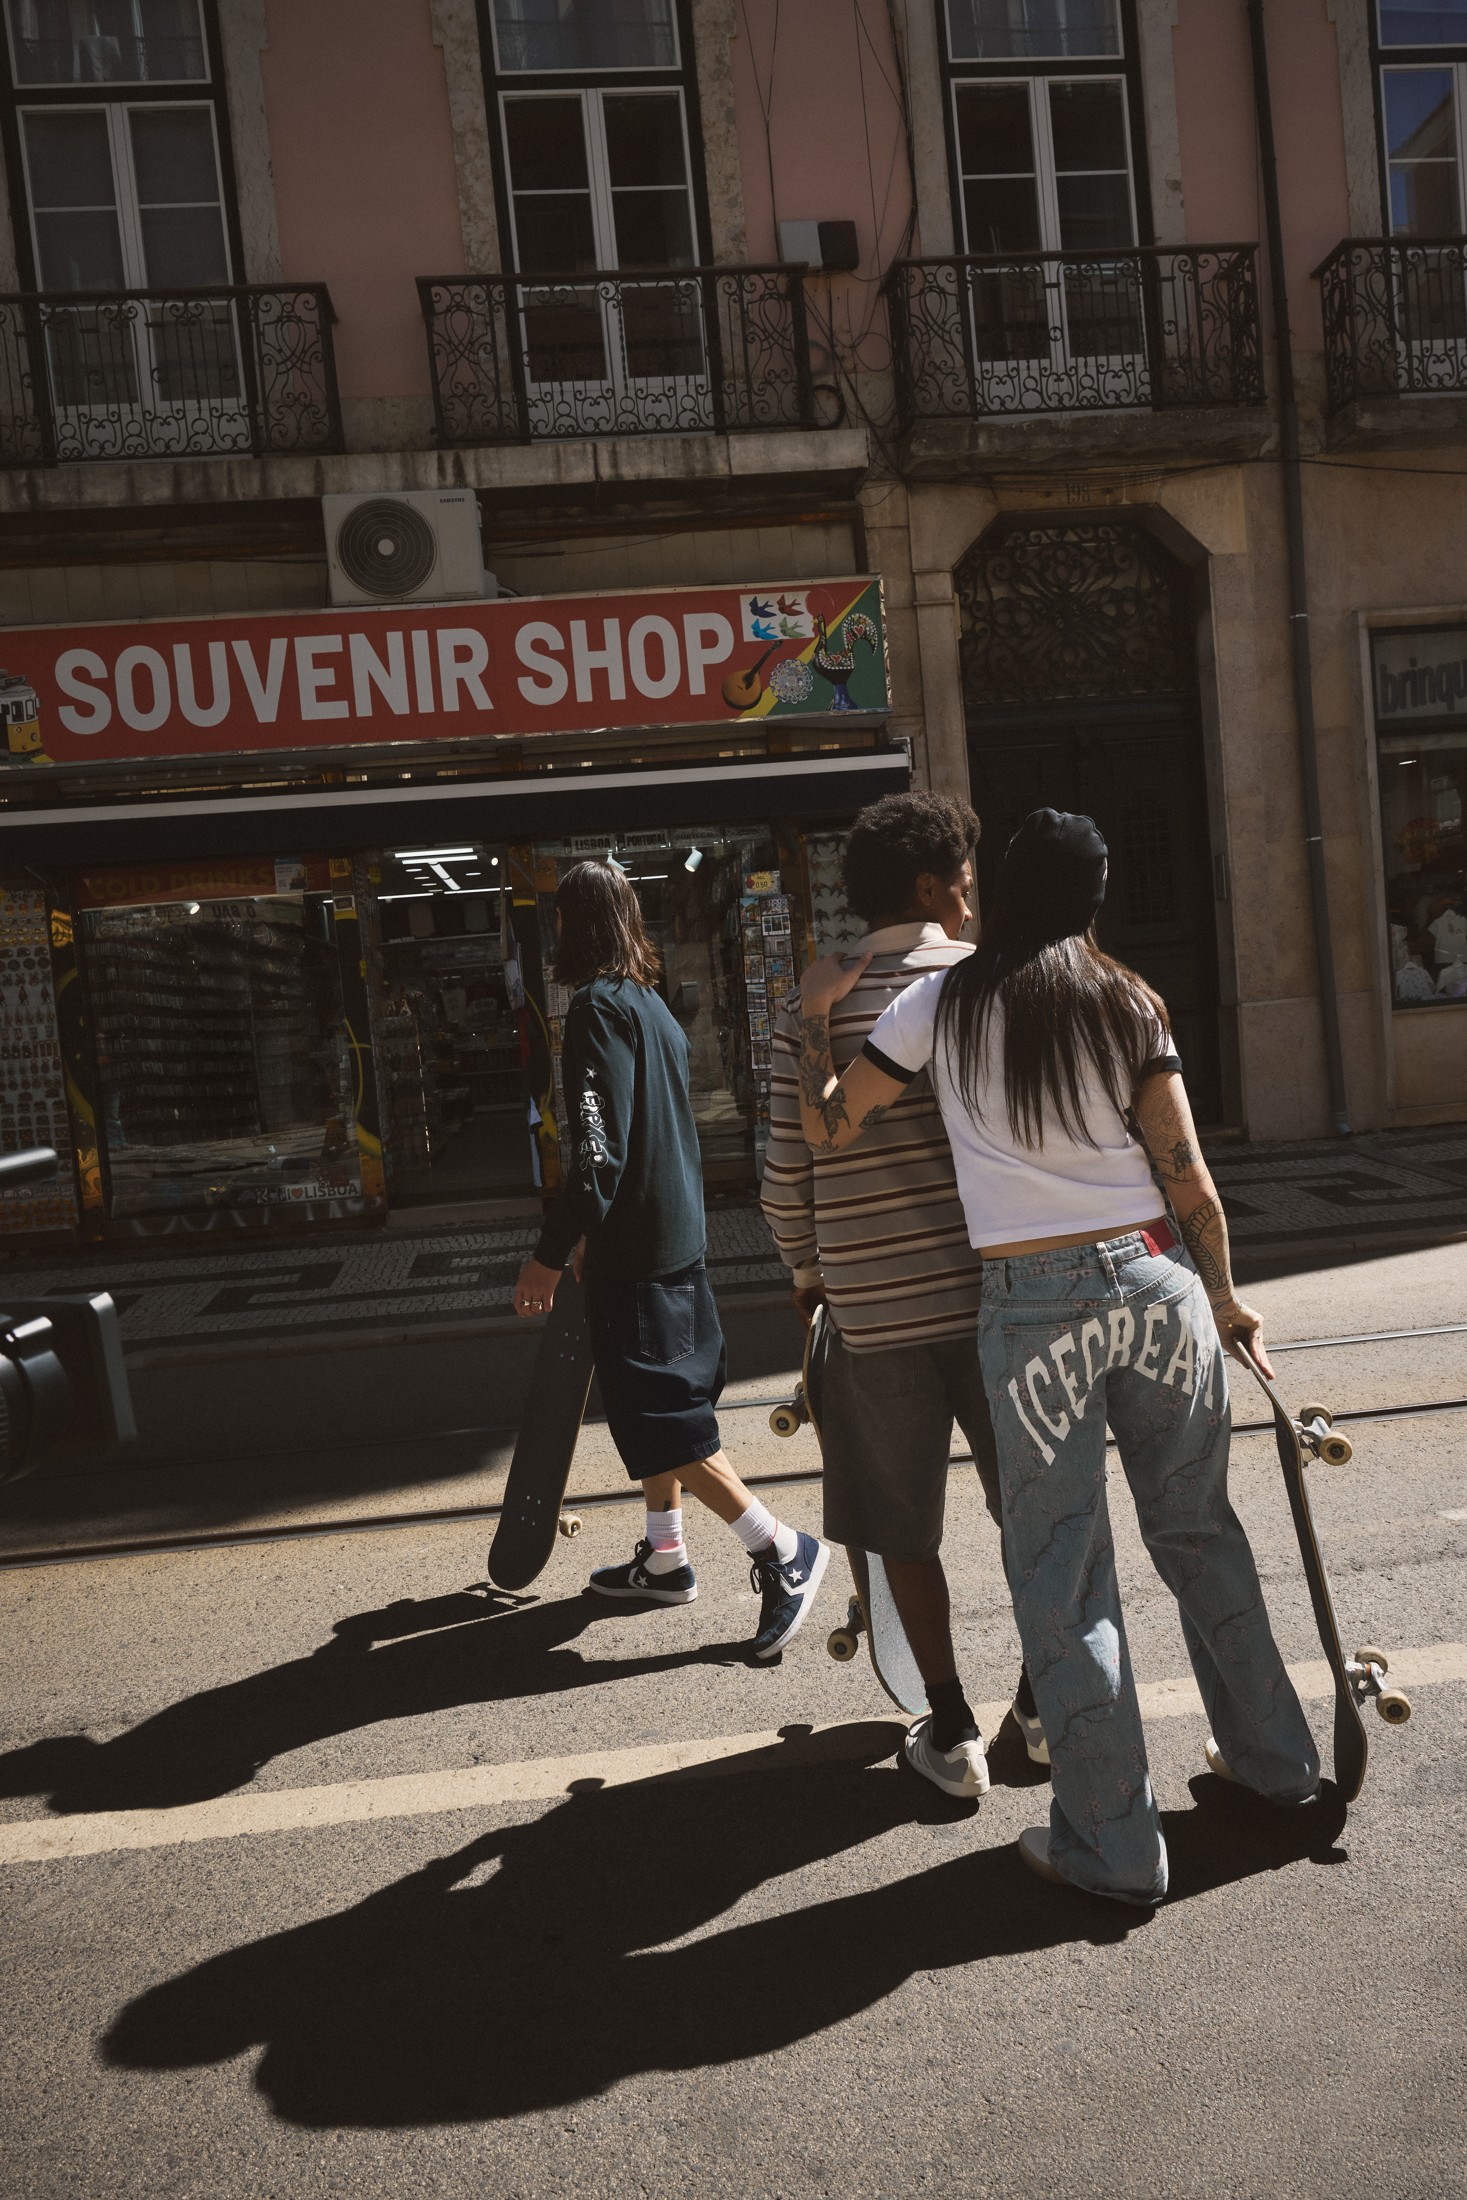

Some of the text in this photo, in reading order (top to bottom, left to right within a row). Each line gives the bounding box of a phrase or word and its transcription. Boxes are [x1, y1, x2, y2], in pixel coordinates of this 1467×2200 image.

[54, 612, 734, 735] SOUVENIR SHOP
[574, 838, 612, 851] LISBOA
[626, 833, 666, 847] PORTUGAL
[92, 867, 274, 899] COLD DRINKS
[305, 1183, 358, 1199] LISBOA
